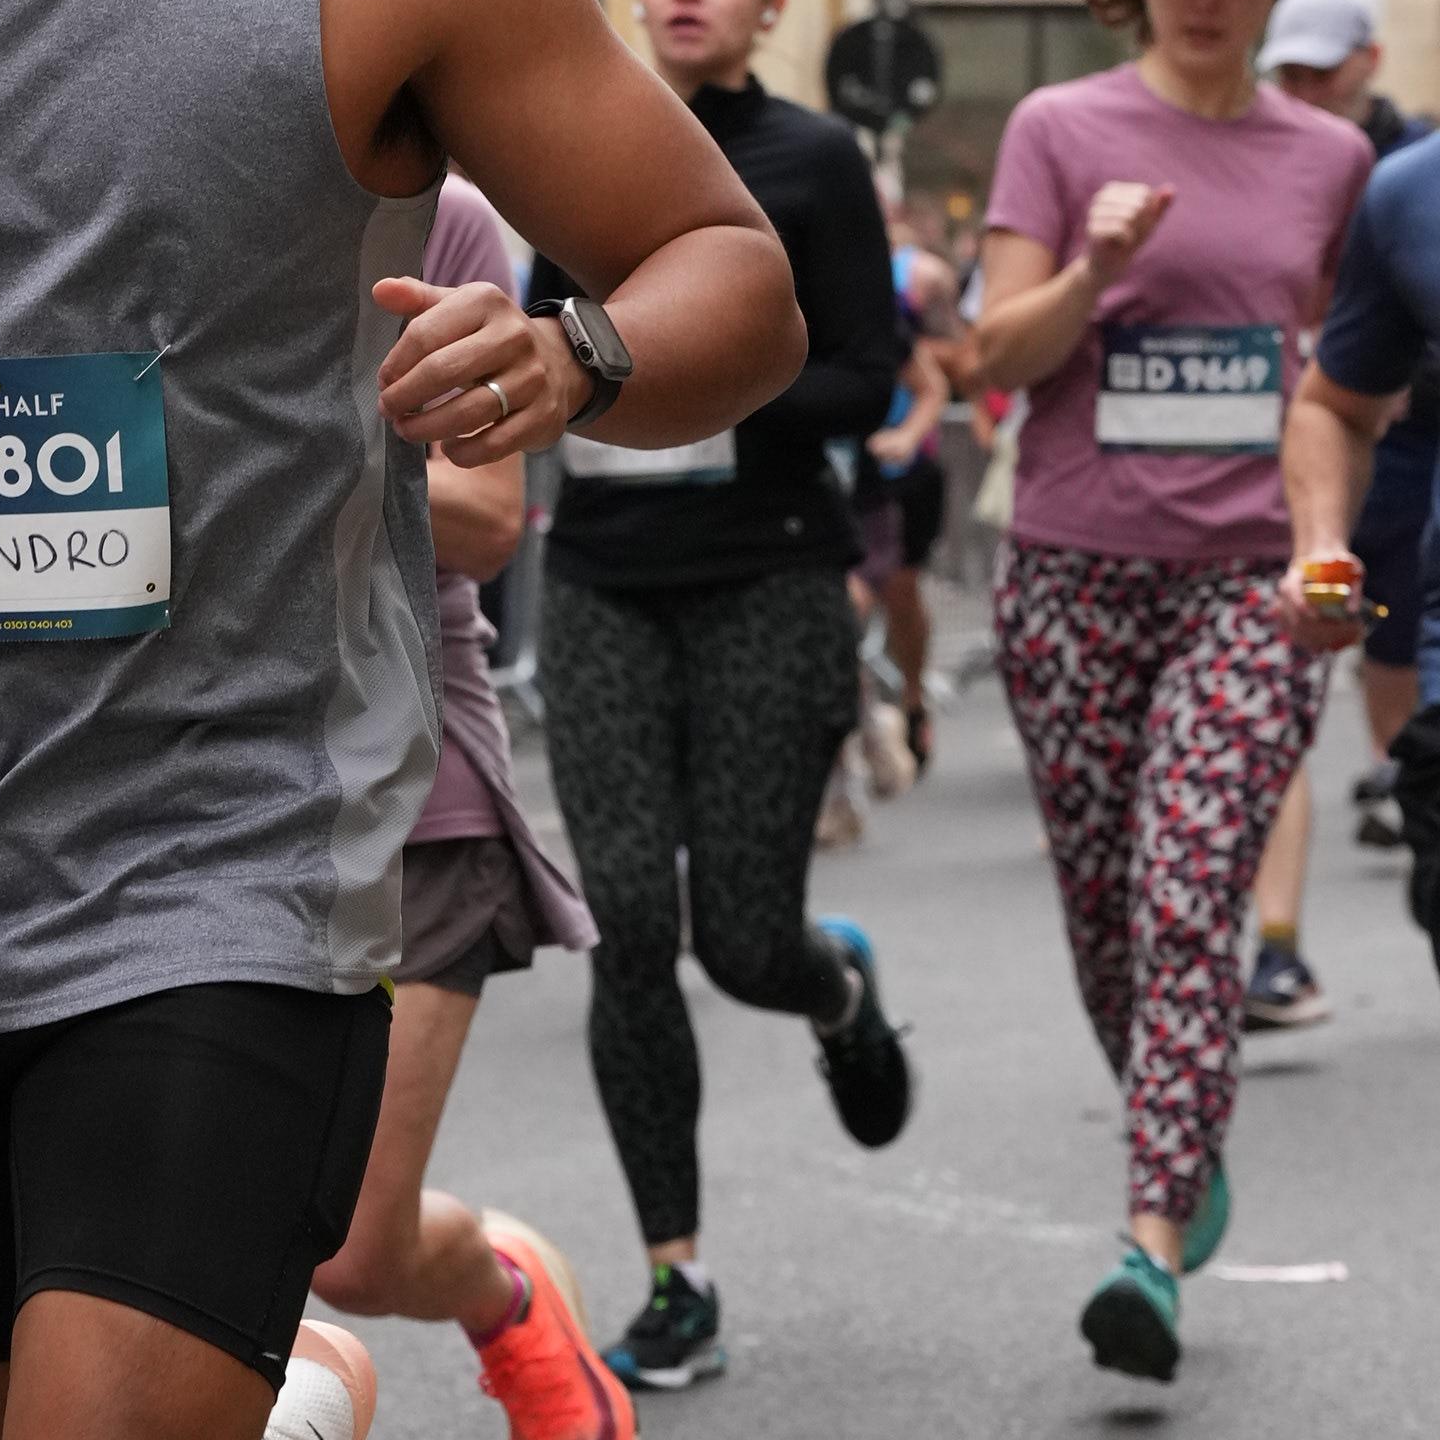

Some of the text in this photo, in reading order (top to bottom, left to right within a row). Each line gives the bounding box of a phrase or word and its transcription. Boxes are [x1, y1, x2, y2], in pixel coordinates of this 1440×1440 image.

[1145, 355, 1176, 392] D
[3, 621, 27, 630] 0303
[28, 620, 53, 629] 0401
[54, 619, 73, 629] 403
